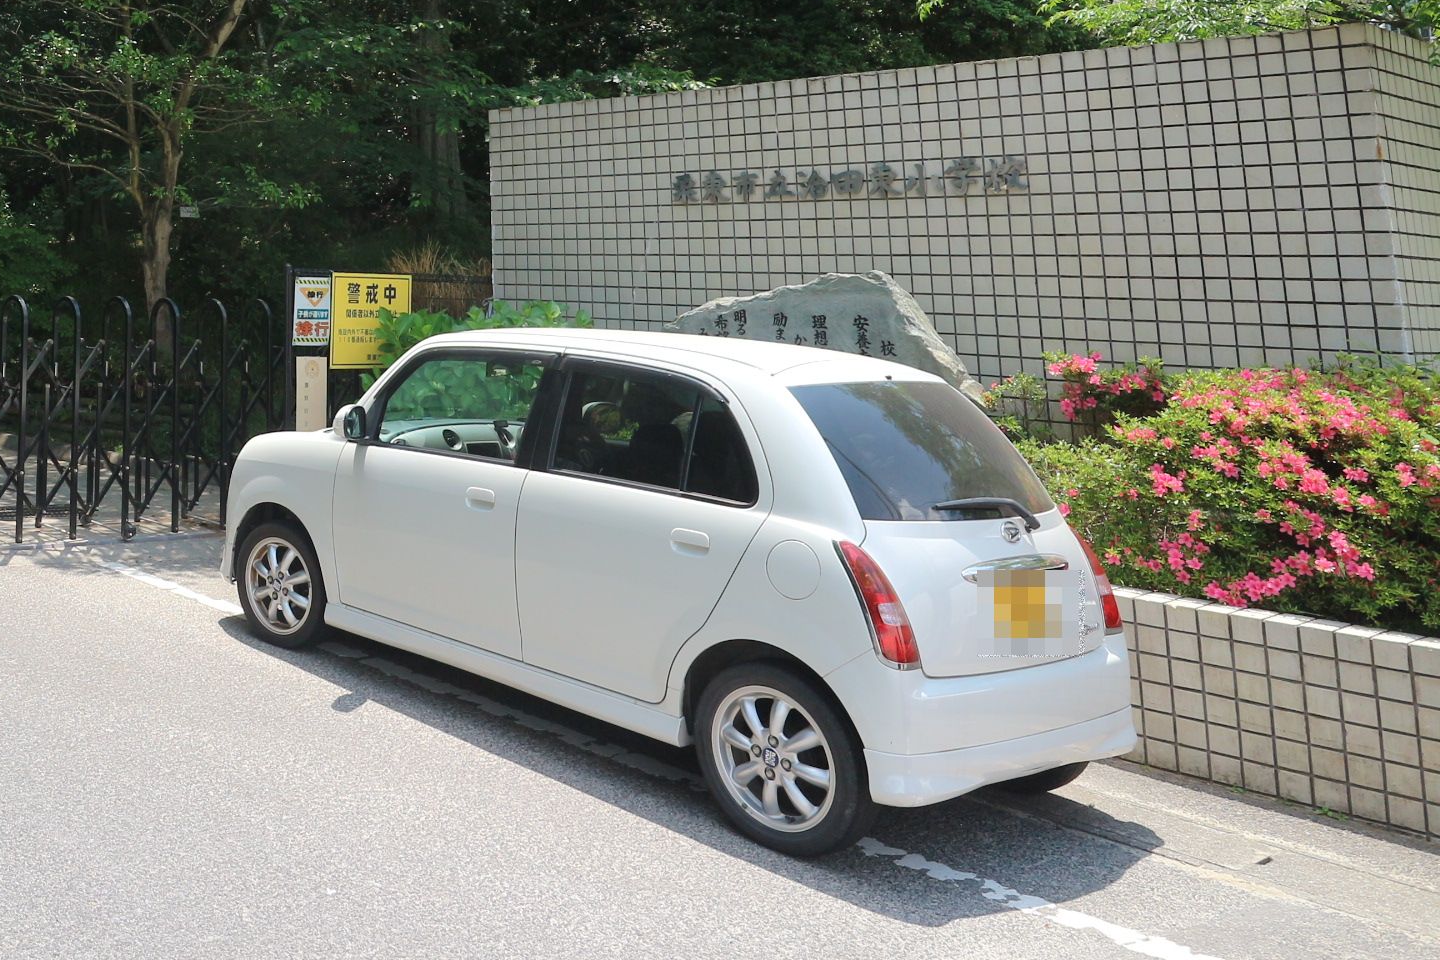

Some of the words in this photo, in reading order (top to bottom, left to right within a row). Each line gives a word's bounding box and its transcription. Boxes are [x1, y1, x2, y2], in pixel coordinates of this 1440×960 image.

[673, 156, 1029, 202] 栗東市立治田東小学校
[347, 282, 397, 305] 警戒中
[295, 320, 329, 337] 徐行
[733, 309, 747, 336] 明る
[773, 311, 788, 341] 励ま
[812, 314, 828, 346] 理想
[880, 340, 897, 357] 校
